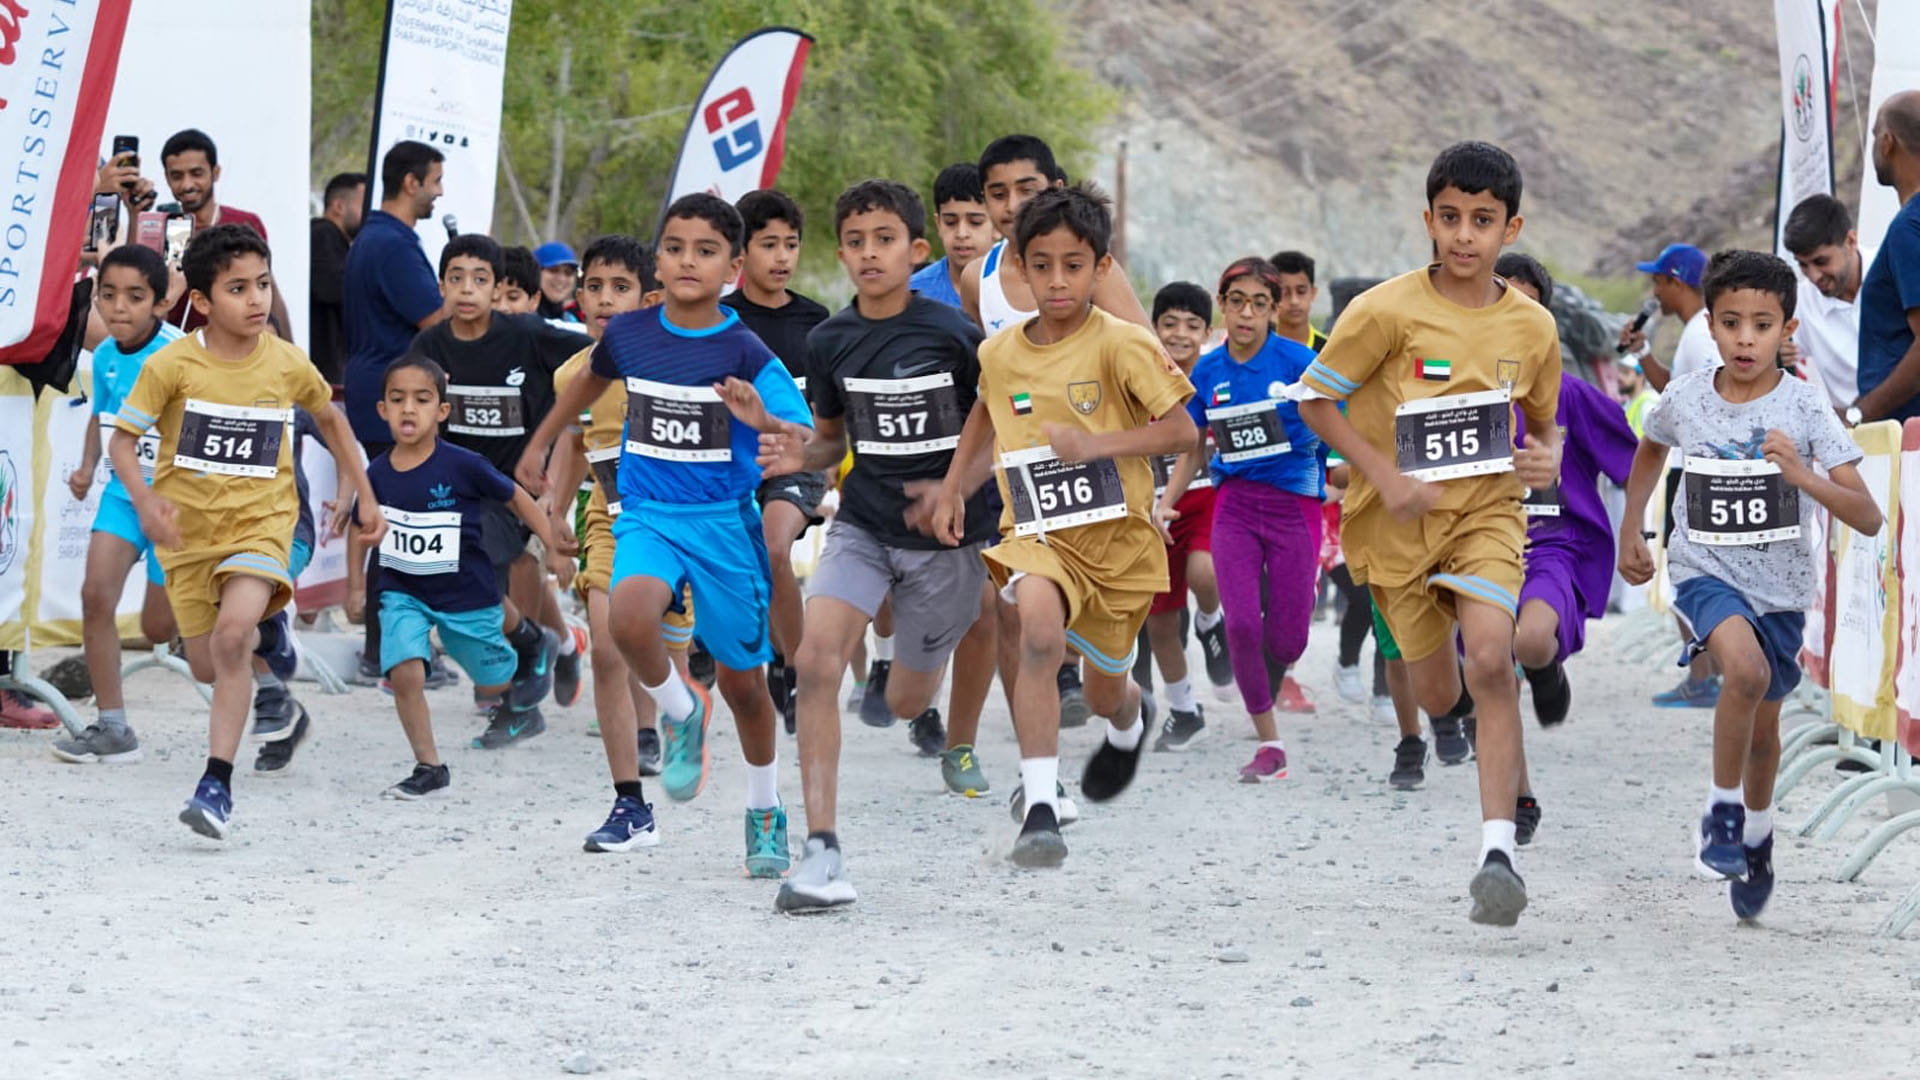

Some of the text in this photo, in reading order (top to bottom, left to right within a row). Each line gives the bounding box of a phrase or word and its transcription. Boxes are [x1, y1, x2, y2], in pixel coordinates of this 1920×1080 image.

[465, 408, 502, 426] 532
[878, 411, 929, 437] 517
[651, 417, 702, 445] 504
[1231, 427, 1267, 448] 528
[203, 434, 253, 460] 514
[1425, 428, 1479, 461] 515
[1039, 477, 1093, 511] 516
[1710, 498, 1768, 525] 518
[392, 530, 443, 555] 1104
